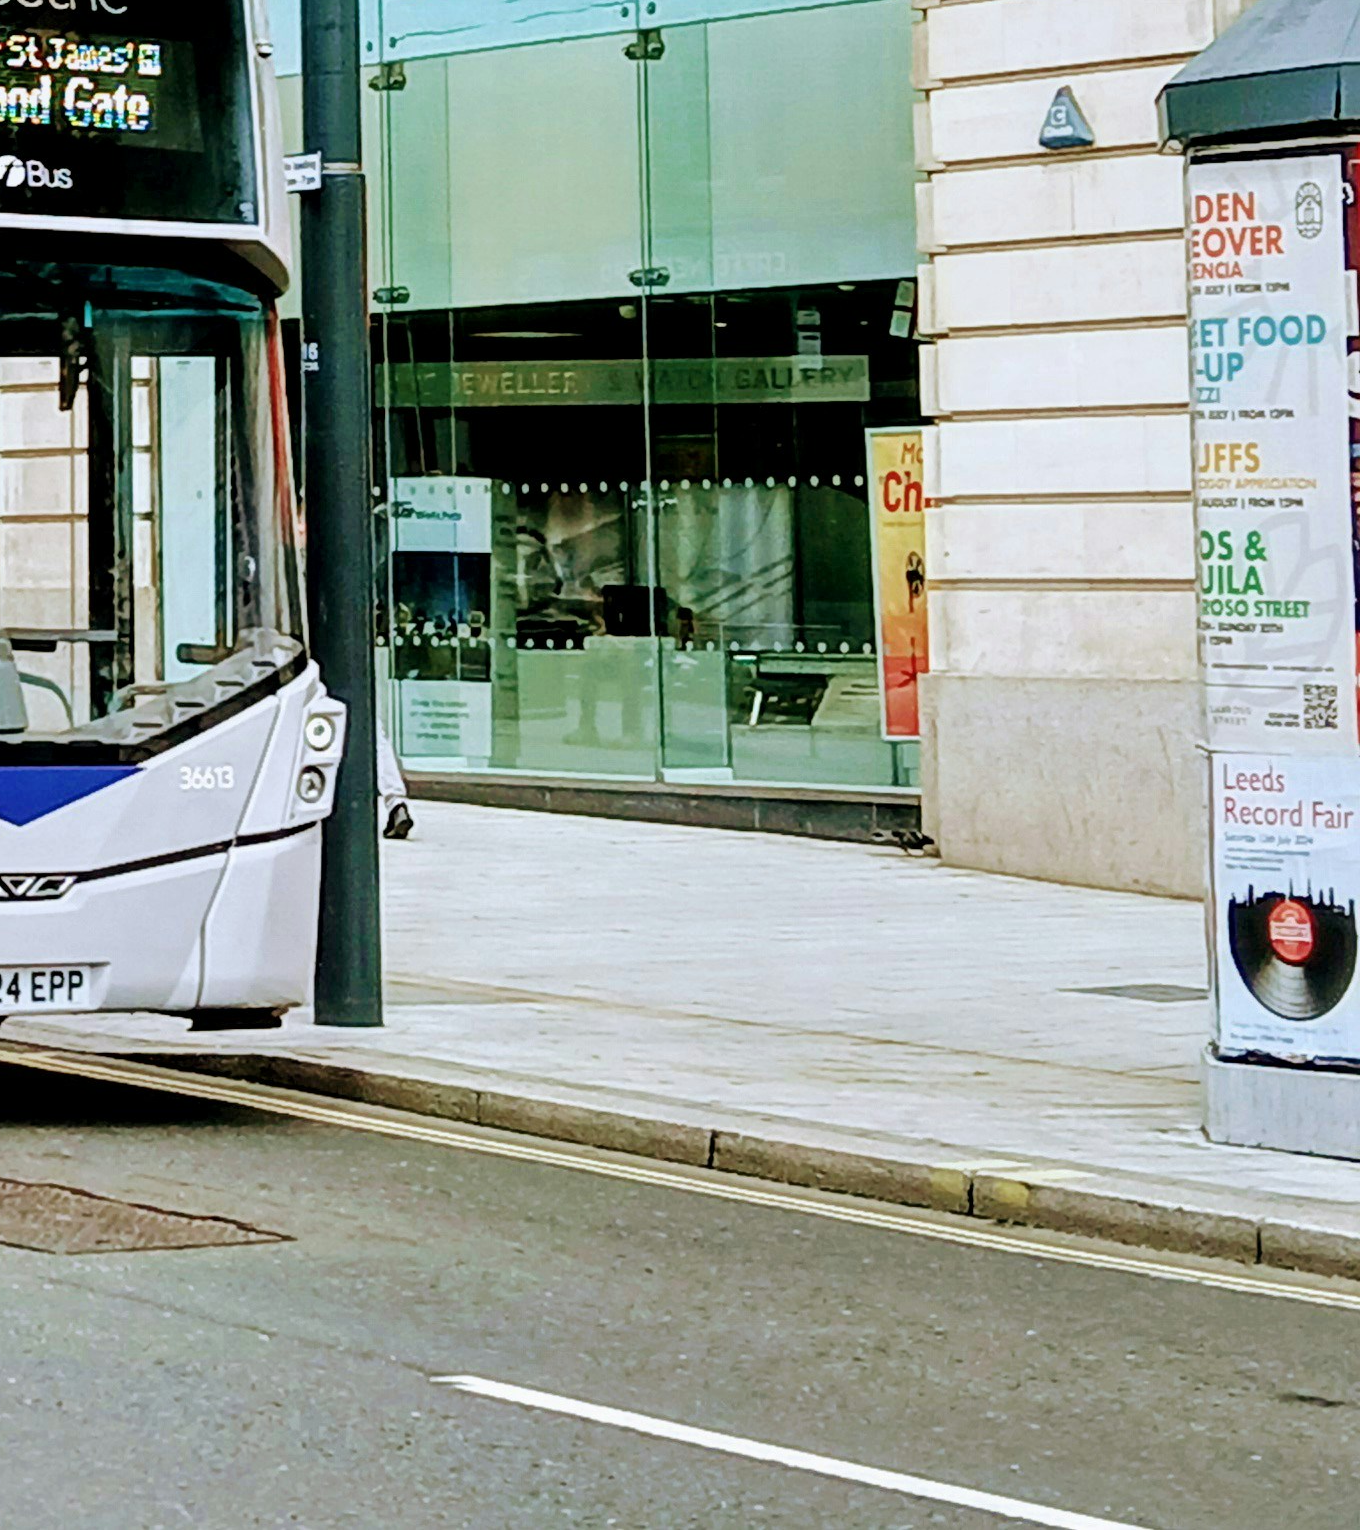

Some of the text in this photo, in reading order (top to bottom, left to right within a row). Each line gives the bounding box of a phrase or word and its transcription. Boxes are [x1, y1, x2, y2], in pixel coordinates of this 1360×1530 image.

[6, 33, 42, 68] St
[64, 76, 151, 130] Gate
[28, 159, 73, 190] Bus
[1195, 191, 1255, 224] DEN
[1238, 314, 1327, 347] FOOD
[1244, 529, 1268, 561] &
[1253, 600, 1311, 618] STREET
[180, 765, 234, 790] 36613
[1223, 760, 1285, 793] Leeds
[1223, 797, 1355, 829] Record Fair
[30, 970, 84, 1002] EPP
